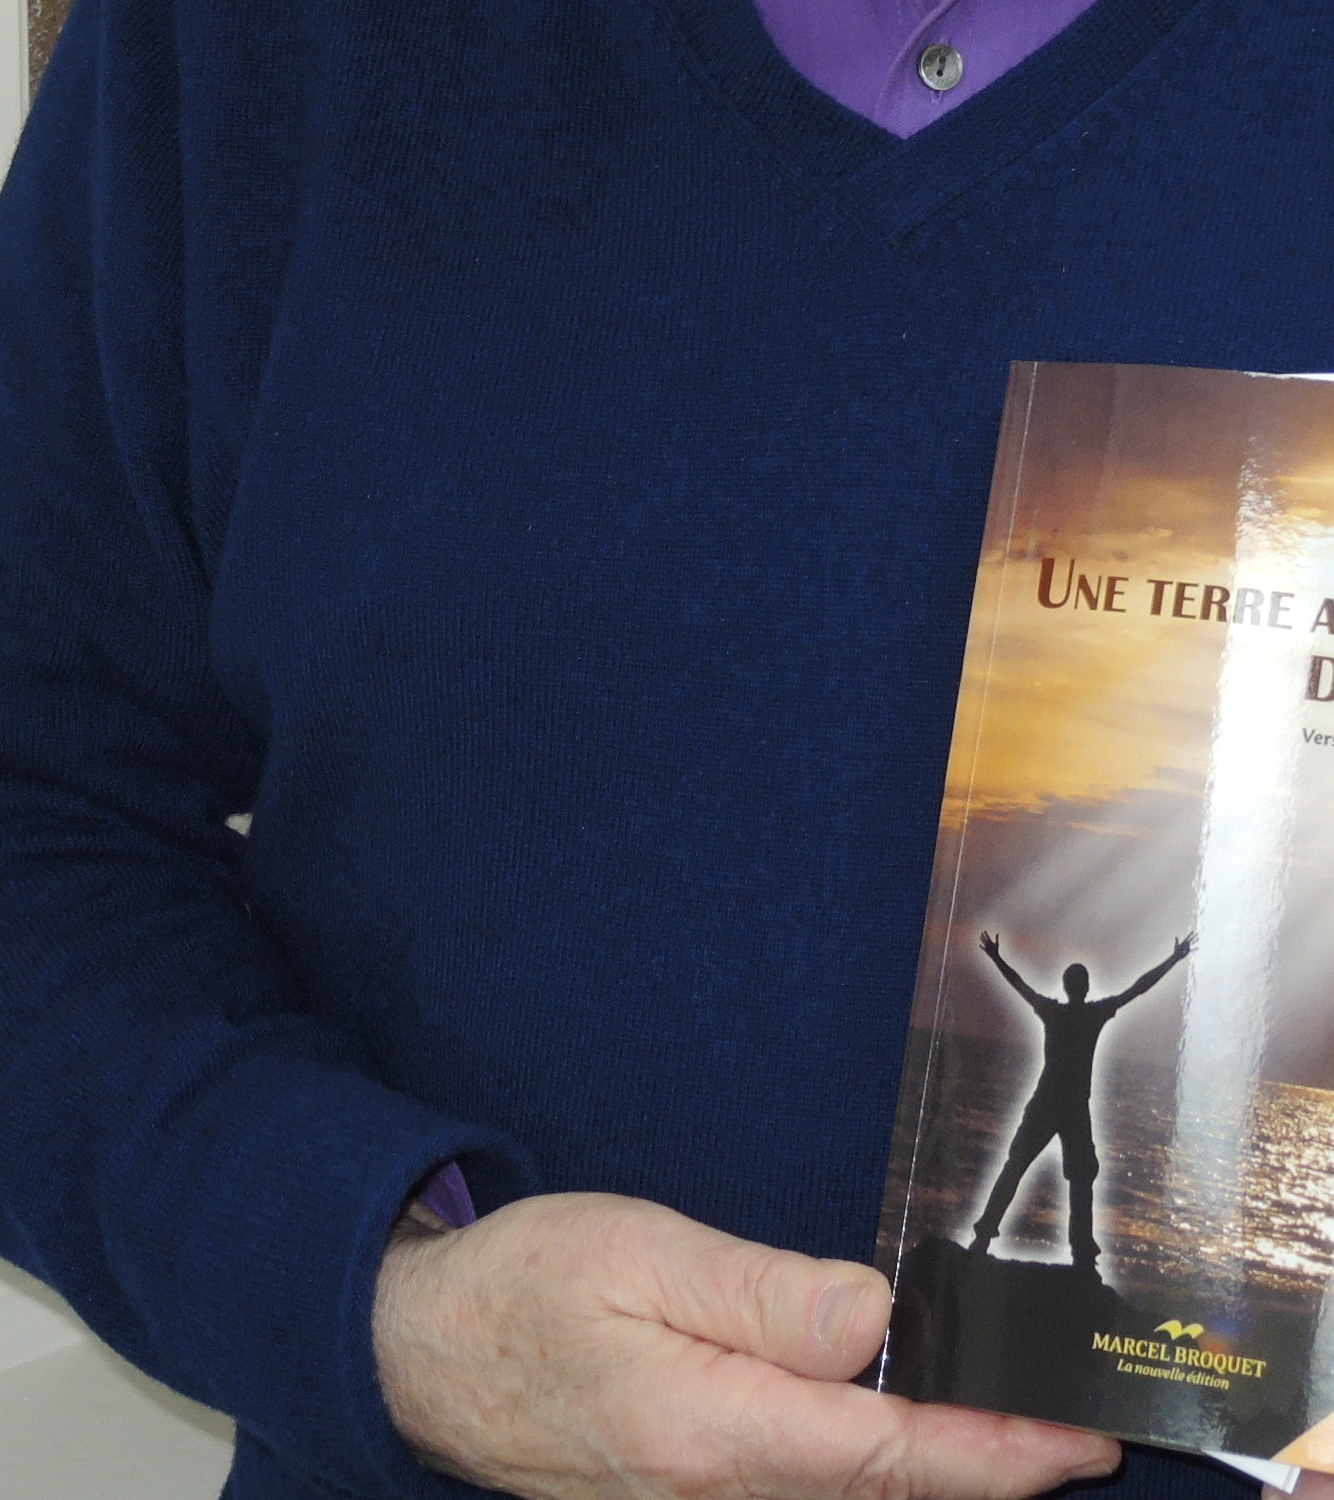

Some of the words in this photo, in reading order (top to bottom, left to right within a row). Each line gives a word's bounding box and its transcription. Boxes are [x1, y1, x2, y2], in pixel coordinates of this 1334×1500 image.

[1146, 578, 1295, 631] TERRE
[1091, 1331, 1172, 1363] MARCEL
[1173, 1345, 1267, 1379] BROQUET
[1116, 1357, 1134, 1373] La
[1133, 1363, 1186, 1382] nouvelle
[1185, 1370, 1231, 1390] édition
